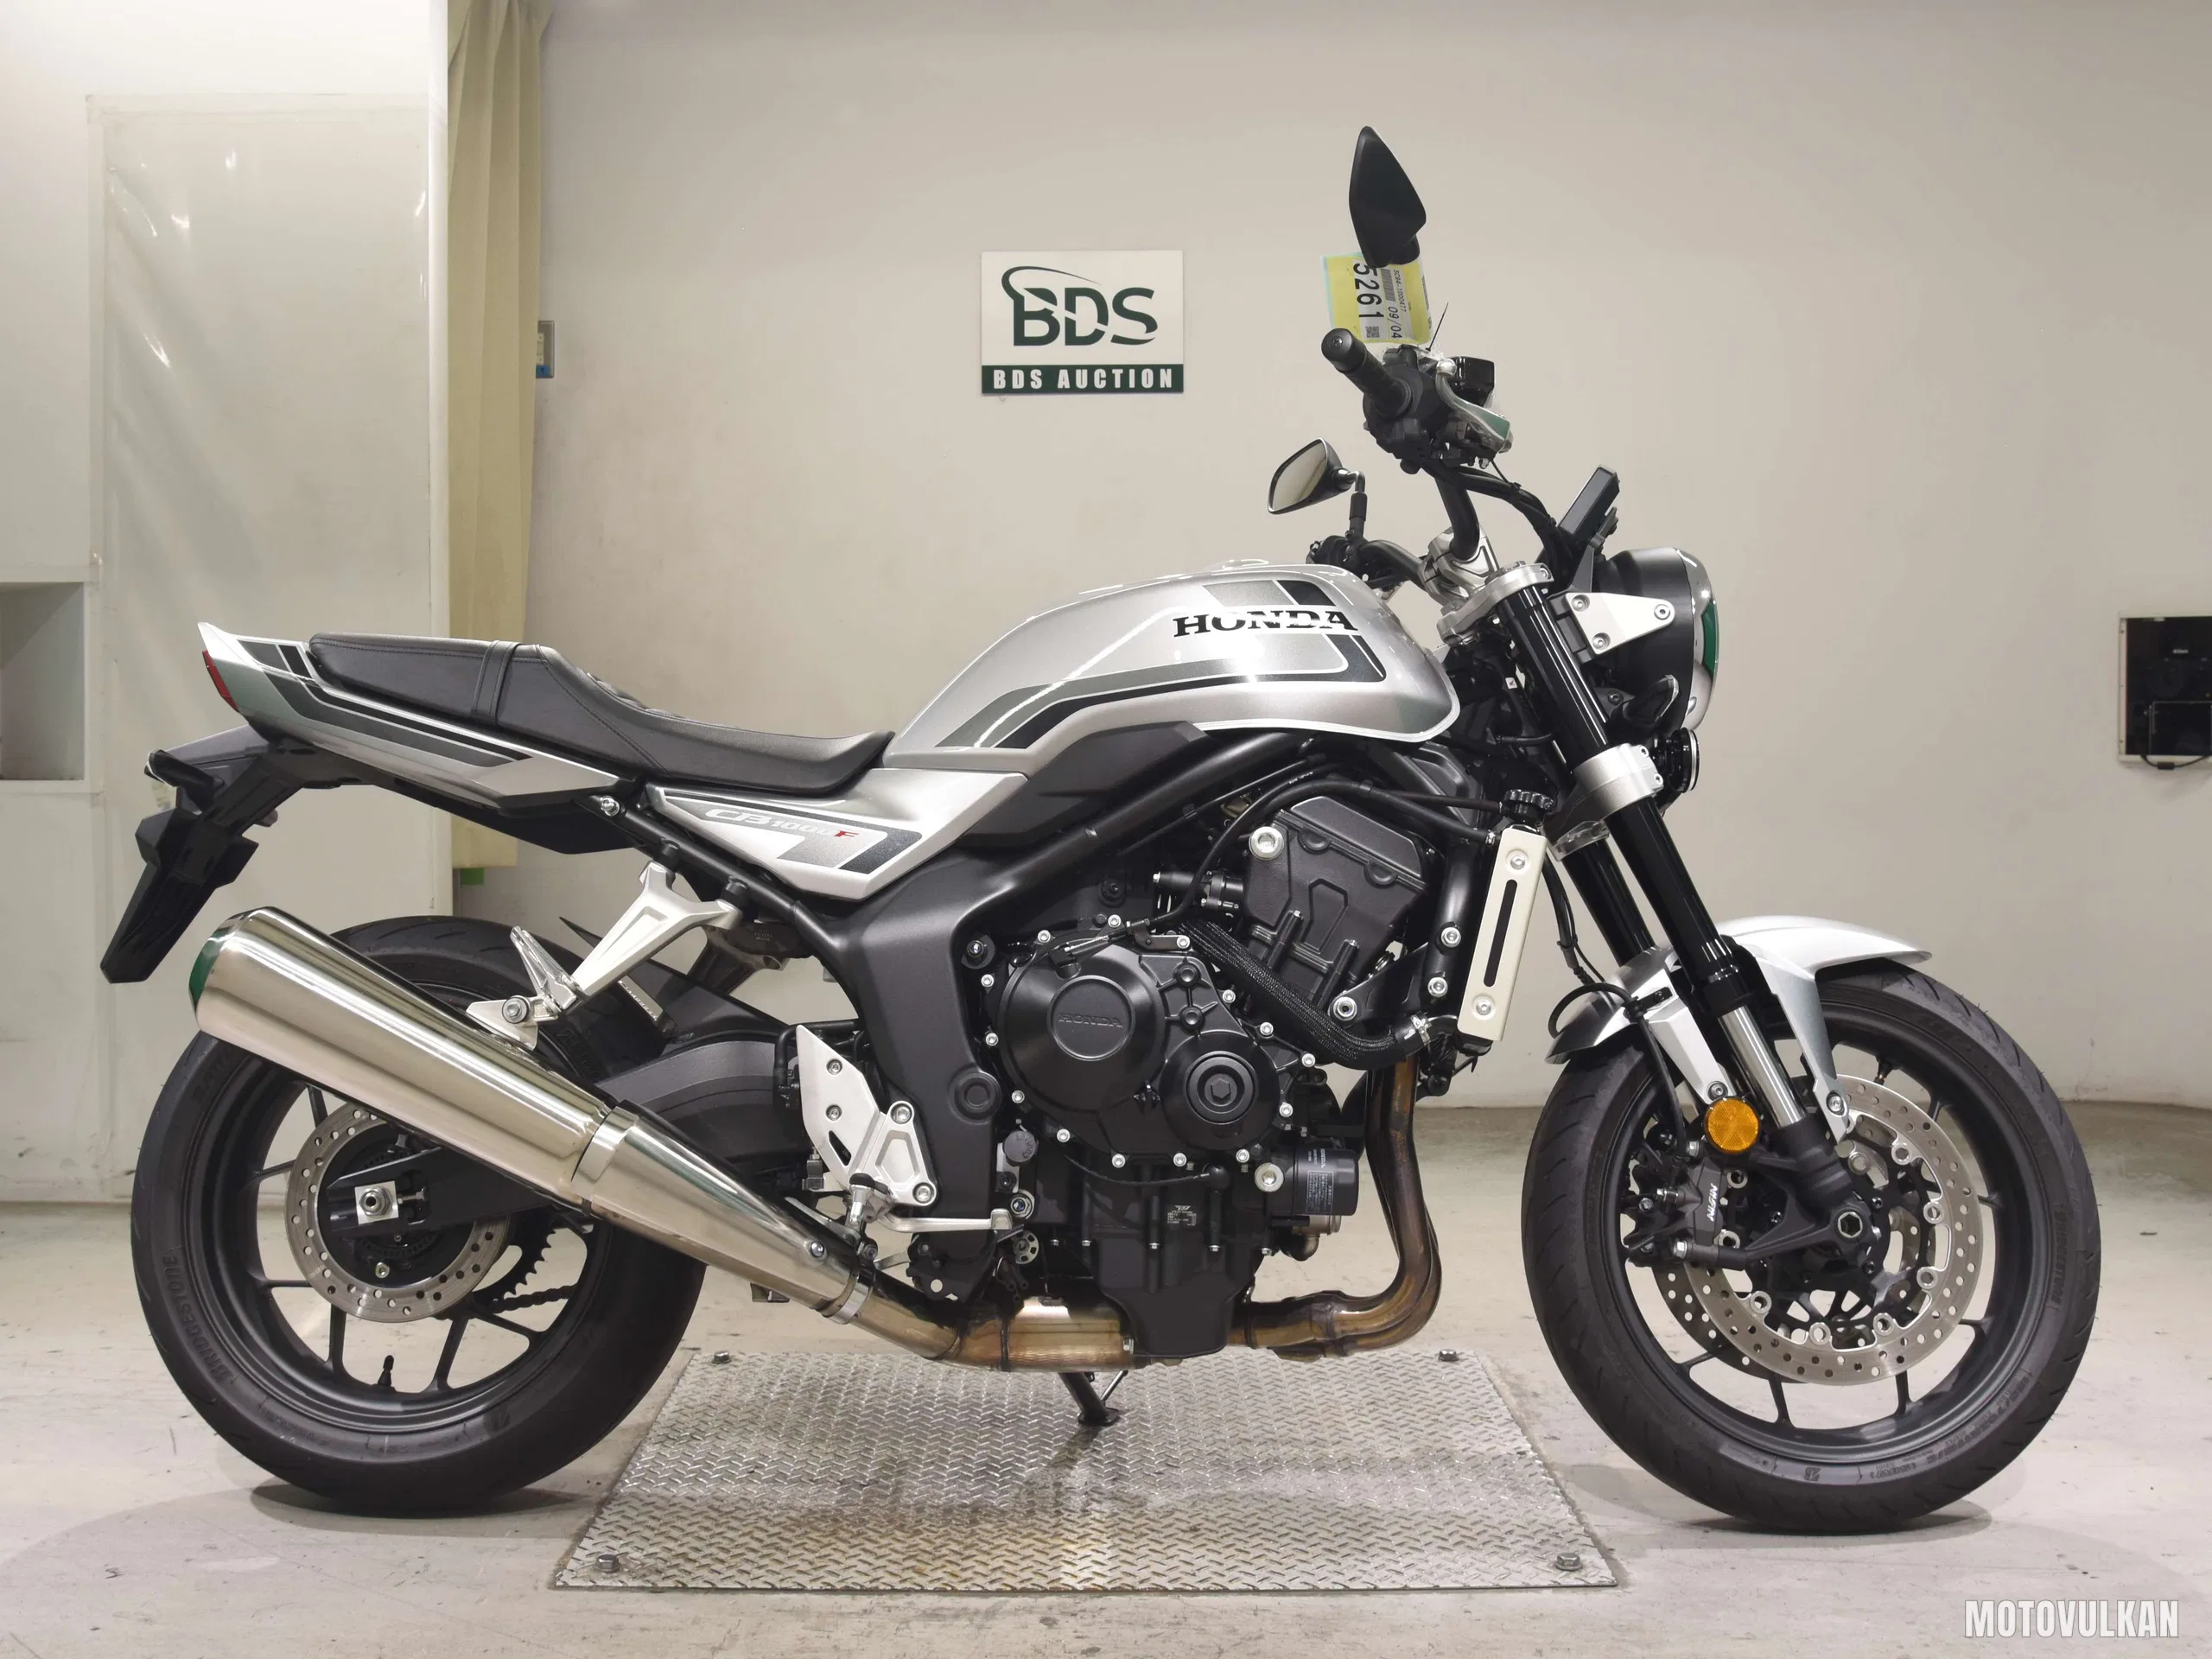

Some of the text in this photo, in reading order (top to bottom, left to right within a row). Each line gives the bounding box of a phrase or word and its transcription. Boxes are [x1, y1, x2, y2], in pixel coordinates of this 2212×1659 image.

[1001, 266, 1158, 346] BDS
[1353, 264, 1384, 317] 5261
[1388, 306, 1402, 339] 09/04
[994, 368, 1172, 389] BDS AUCTION
[1173, 610, 1357, 638] HONDA
[1058, 1014, 1122, 1027] HONDA
[162, 1255, 232, 1382] BRIDGESTONE
